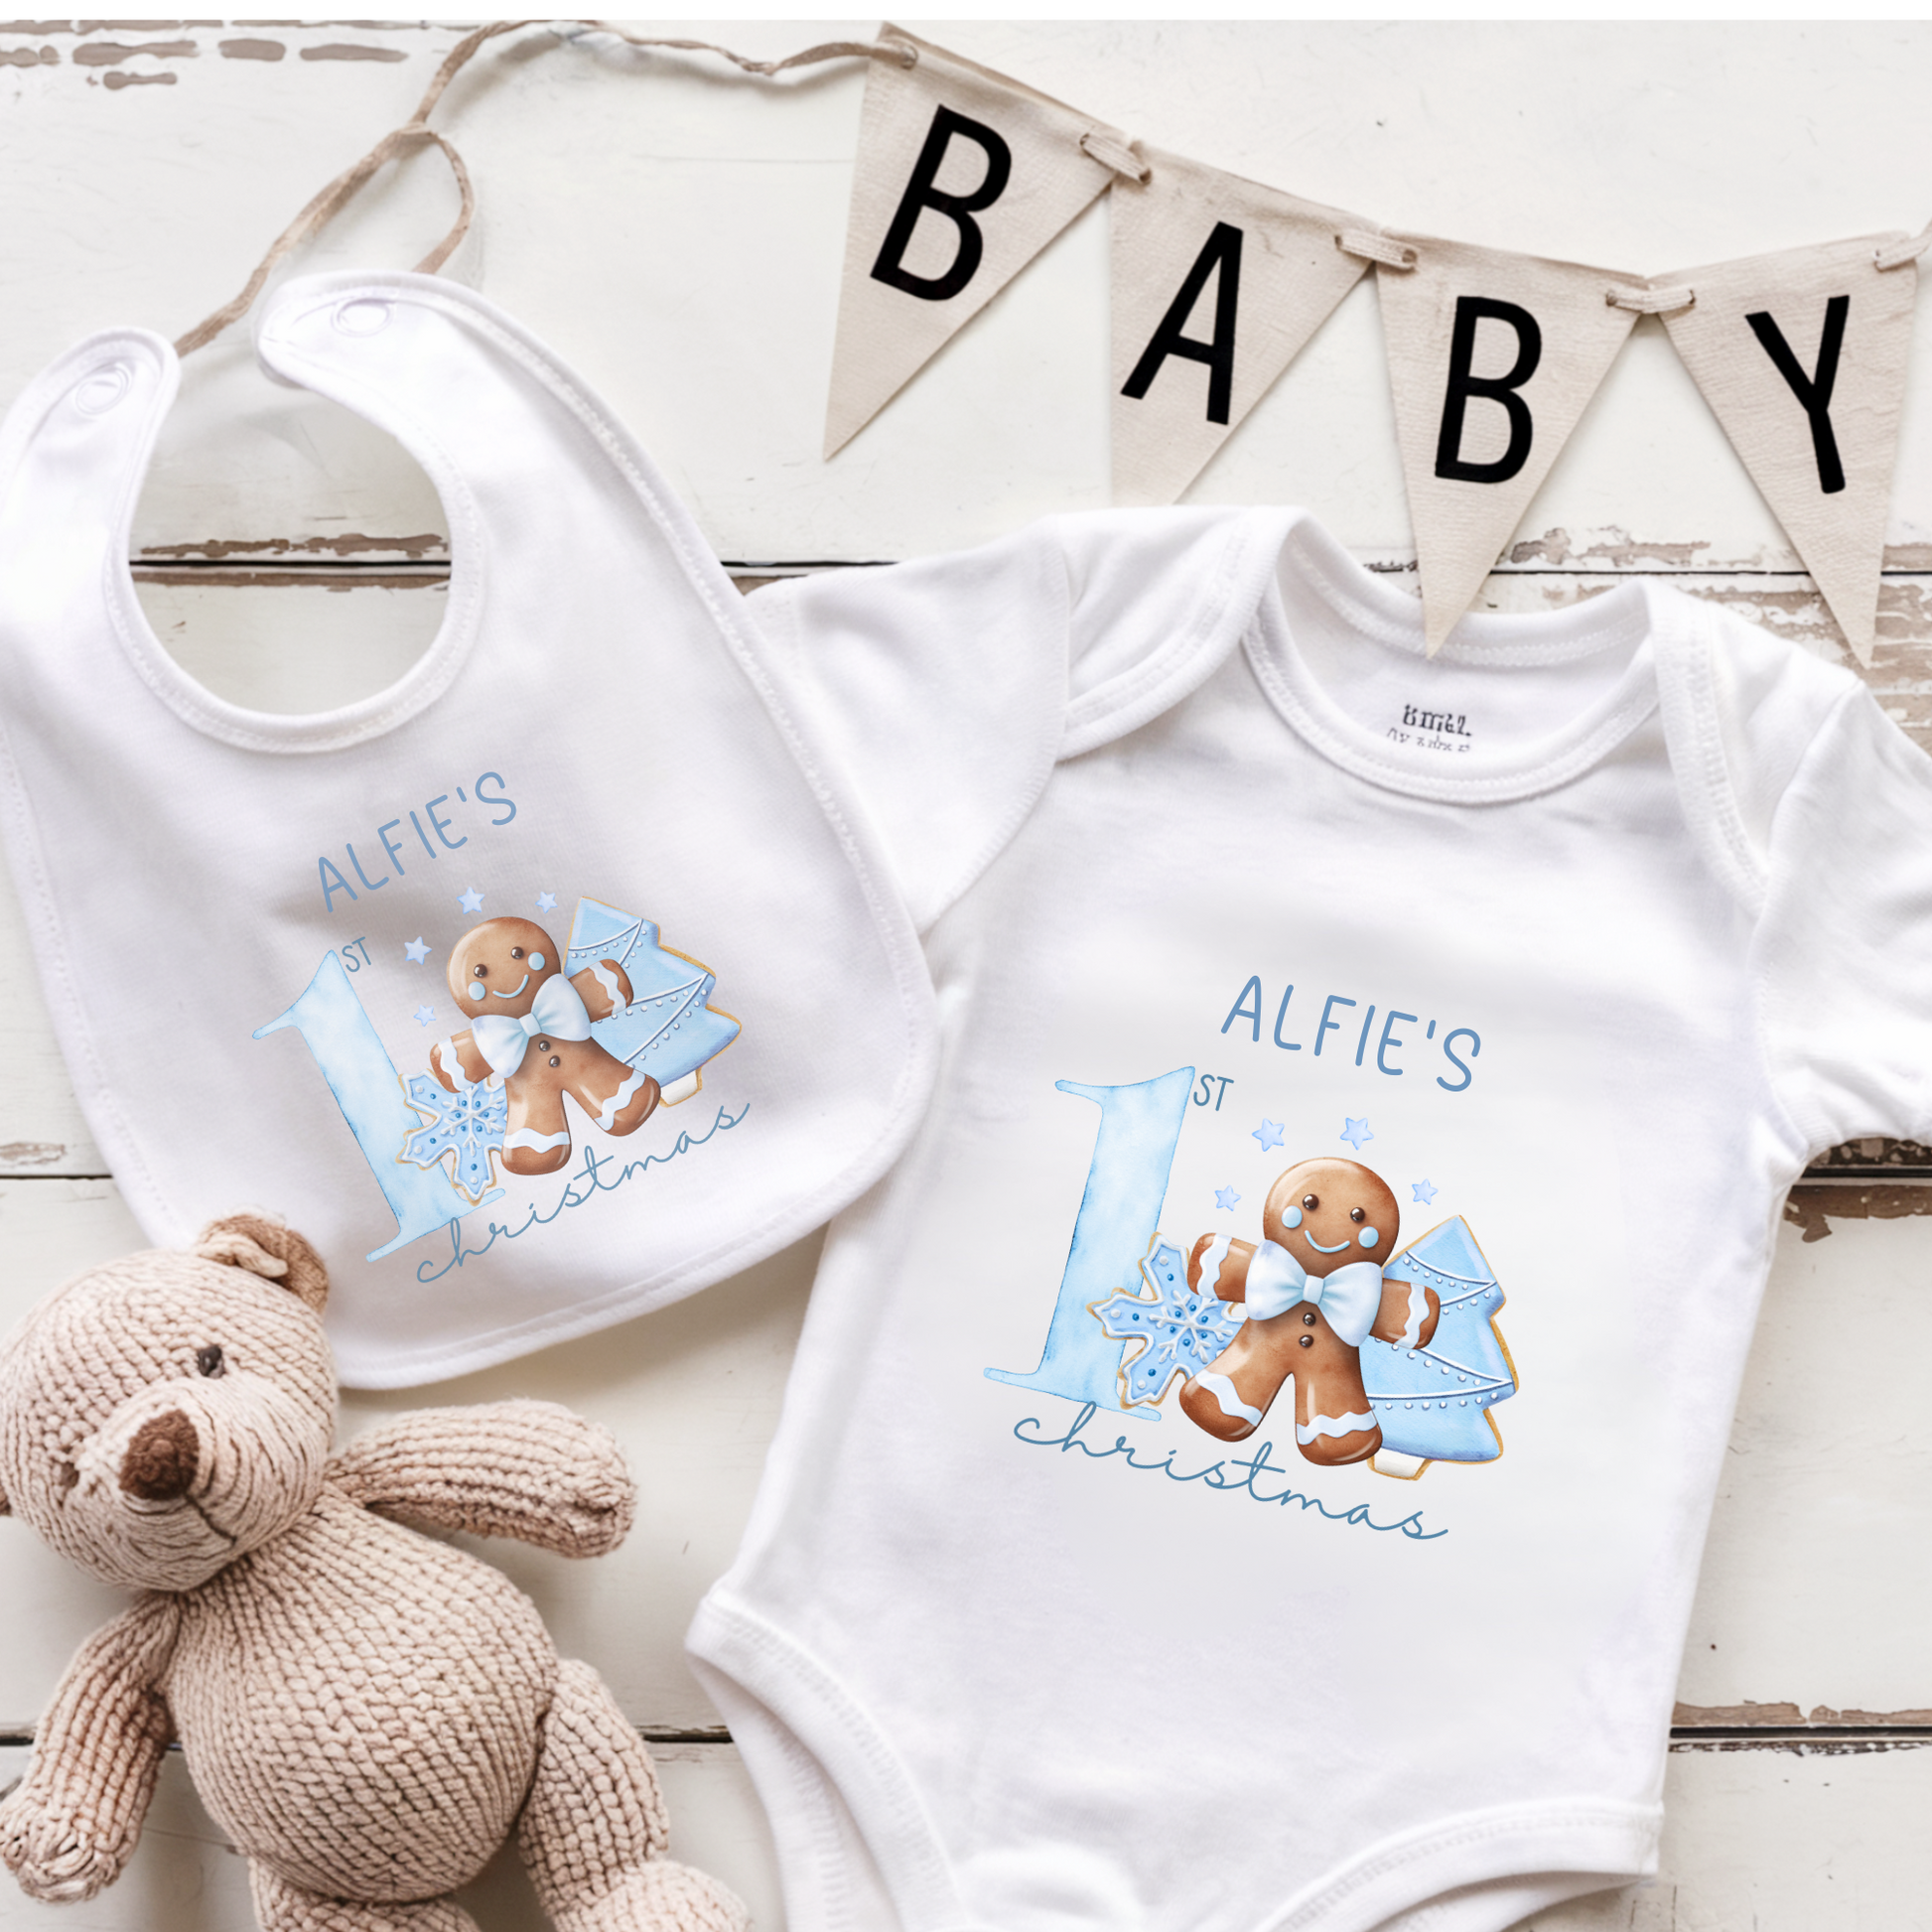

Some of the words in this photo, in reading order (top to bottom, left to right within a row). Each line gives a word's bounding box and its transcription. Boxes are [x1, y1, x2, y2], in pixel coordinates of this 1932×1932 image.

[871, 105, 1850, 494] BABY
[318, 770, 517, 913] ALFIE'S
[1220, 975, 1481, 1093] ALFIE'S
[416, 1102, 751, 1284] christmas
[1013, 1400, 1449, 1541] christmas
